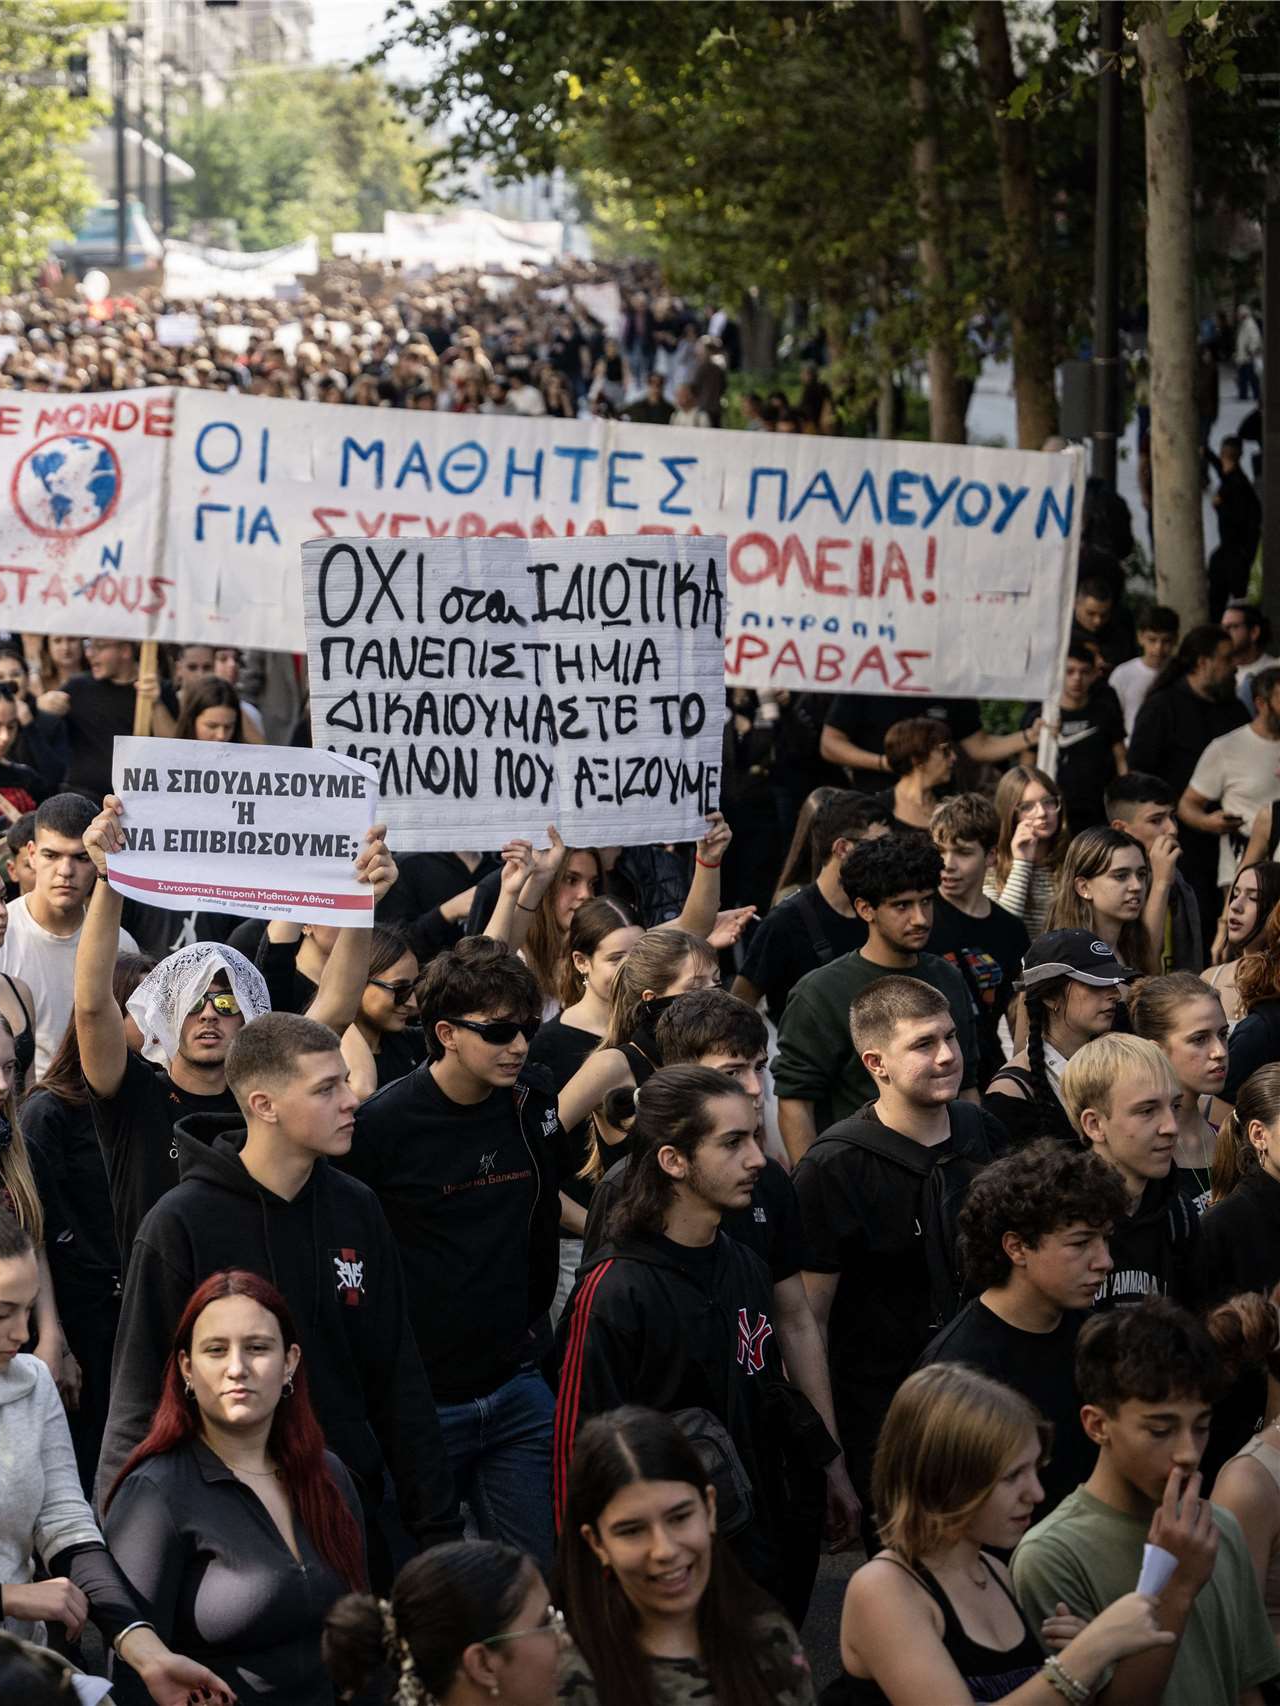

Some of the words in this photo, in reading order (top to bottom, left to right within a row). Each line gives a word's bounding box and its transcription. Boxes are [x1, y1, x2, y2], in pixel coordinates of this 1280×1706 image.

[35, 399, 176, 438] MONDE
[194, 421, 270, 484] ΟΙ
[339, 436, 699, 515] ΜΑΘΗΤΕΣ
[747, 467, 1074, 540] ΠΑΛΕΥΟΥΝ
[194, 503, 281, 545] ΓΙΑ
[637, 523, 937, 605] ΟΛΕΙΑ!
[319, 543, 425, 628] ΟΧΙ
[439, 587, 527, 627] στα
[319, 636, 661, 687] ΠΑΝΕΠΙΣΤΗΜΙΑ
[326, 690, 638, 745] ΔΙΚΑΙΟΥΜΑΣΤΕ
[650, 692, 707, 738] ΤΟ
[122, 768, 159, 792] ΝΑ
[166, 768, 367, 799] ΣΠΟΥΔΑΣΟΥΜΕ
[495, 747, 556, 805] ΠΟΥ
[575, 755, 719, 816] ΑΞΙΖΟΥΜΕ
[121, 827, 156, 851] ΝΑ
[163, 828, 360, 861] ΕΠΙΒΙΩΣΟΥΜΕ;
[157, 882, 216, 896] Συντονιστική
[215, 887, 256, 900] Επιτροπή
[257, 890, 300, 903] Μαθητών
[302, 894, 336, 905] Αθήνας
[737, 1307, 773, 1375] NY
